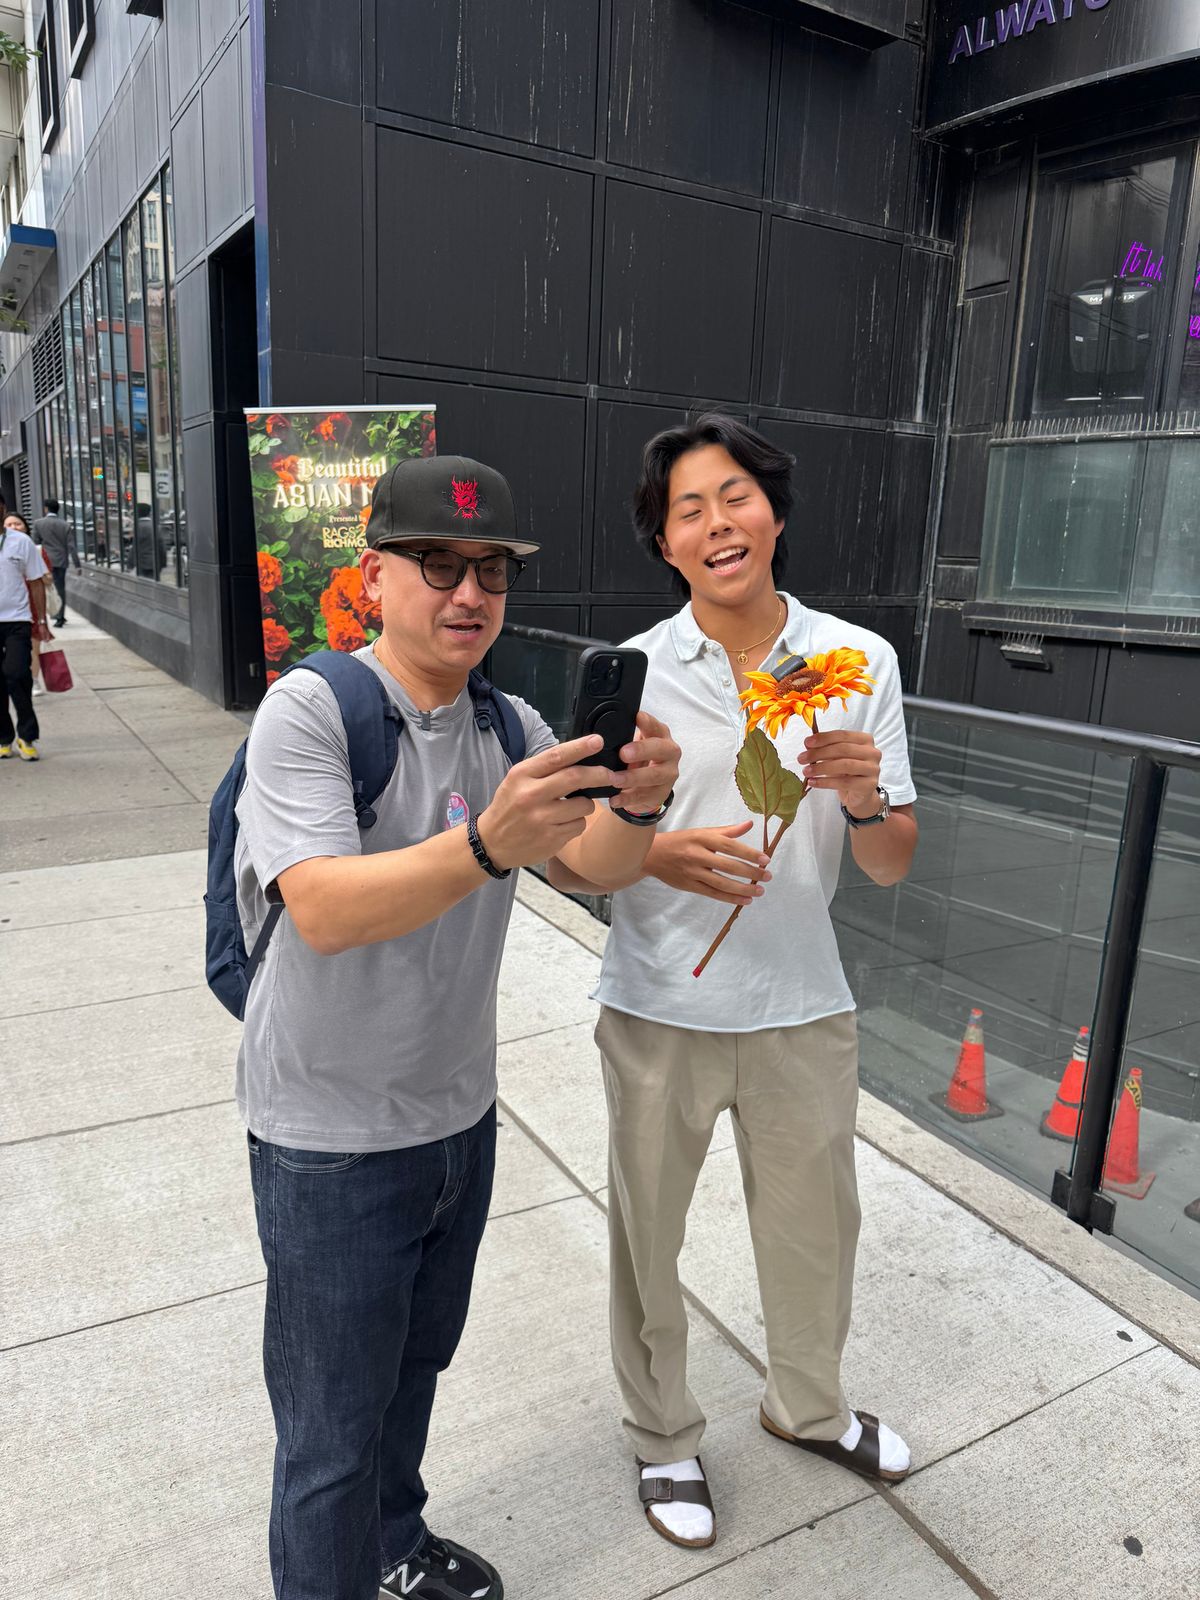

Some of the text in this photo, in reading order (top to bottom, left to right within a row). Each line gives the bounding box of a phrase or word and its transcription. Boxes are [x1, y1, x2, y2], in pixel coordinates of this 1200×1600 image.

[296, 455, 387, 481] Beautiful
[273, 483, 352, 508] ASIAN
[329, 515, 357, 523] Presented
